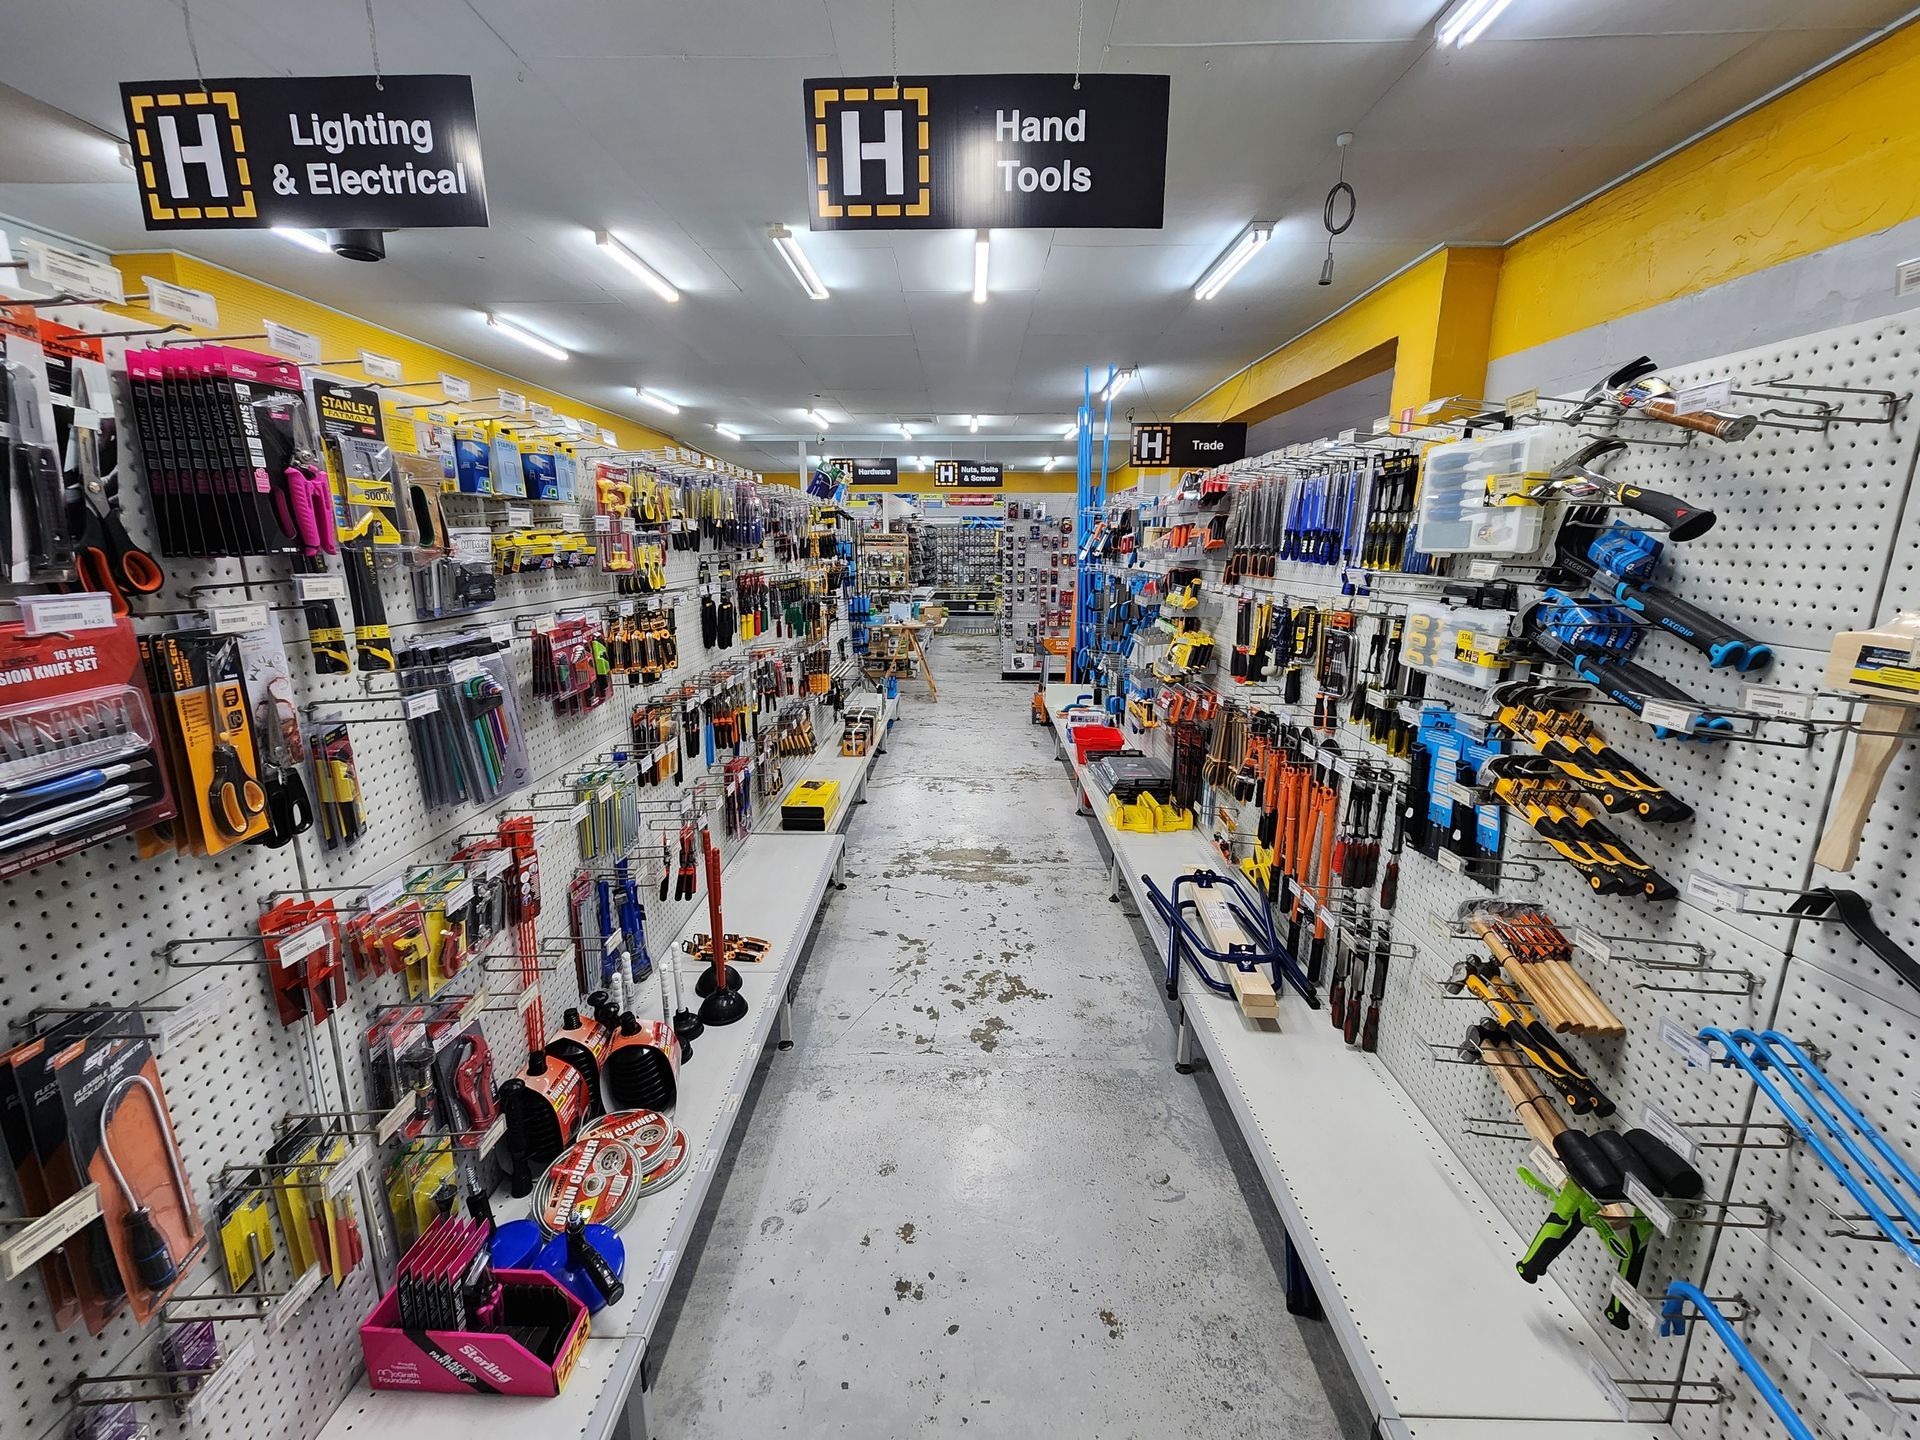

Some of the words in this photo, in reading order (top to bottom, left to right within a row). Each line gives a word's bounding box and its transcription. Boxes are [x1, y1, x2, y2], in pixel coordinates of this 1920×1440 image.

[289, 112, 433, 155] Lighting
[996, 109, 1087, 142] Hand
[157, 113, 229, 199] H
[841, 110, 903, 195] H
[272, 165, 299, 196] &
[307, 161, 468, 197] Electrical
[997, 160, 1092, 193] Tools
[321, 395, 374, 415] STANLEY
[328, 410, 369, 423] FATMAX
[240, 405, 255, 436] SNIPS
[1141, 433, 1163, 459] H
[1192, 440, 1224, 451] Trade
[858, 468, 892, 476] Hardware
[940, 465, 954, 482] H
[961, 466, 980, 474] Nuts,
[1570, 626, 1585, 645] PRO
[1606, 628, 1619, 648] PRO
[1661, 617, 1695, 637] OXGRIP
[1624, 631, 1639, 650] PRO
[53, 650, 66, 660] 16
[67, 646, 96, 658] PIECE
[168, 639, 185, 689] TOLSEN
[33, 661, 74, 680] KNIFE
[74, 658, 98, 673] SET
[1612, 689, 1642, 711] OXGRIP
[1579, 779, 1606, 792] TOLSEN
[74, 1069, 108, 1100] FLEXIBLE
[615, 1113, 658, 1137] CLEANER
[554, 1186, 579, 1225] DRAIN
[570, 1139, 599, 1184] CLEANER
[554, 1173, 568, 1198] WORK
[429, 1351, 461, 1376] PANTHER
[443, 1354, 467, 1374] BLACK
[458, 1342, 513, 1383] Sterling
